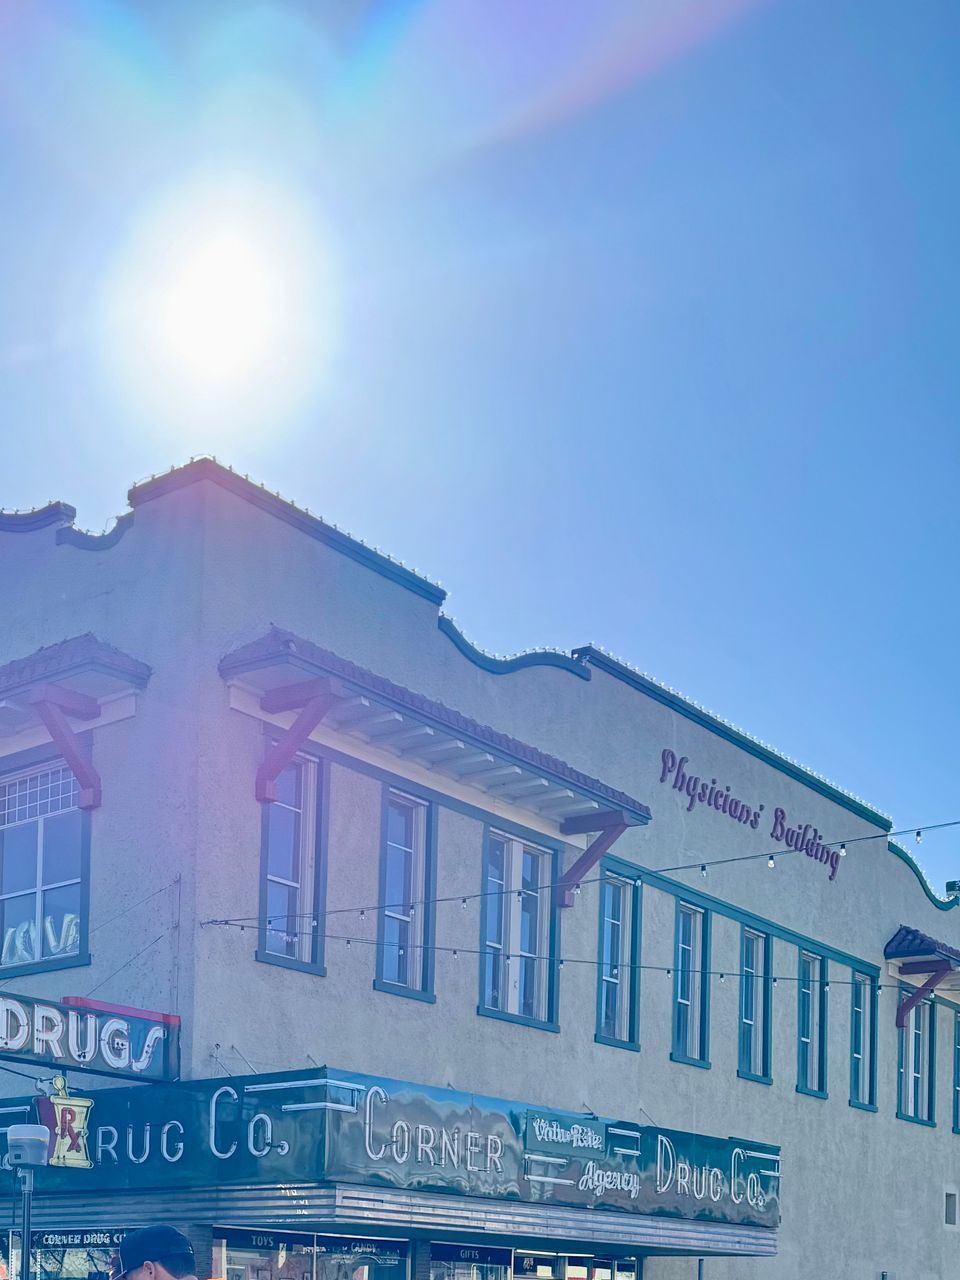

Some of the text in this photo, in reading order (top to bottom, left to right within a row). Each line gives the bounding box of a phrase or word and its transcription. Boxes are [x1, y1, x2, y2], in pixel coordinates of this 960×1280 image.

[770, 807, 840, 881] Building
[96, 1120, 185, 1166] RUG
[365, 1086, 505, 1174] CORNER
[578, 1160, 640, 1199] Agency
[656, 1134, 723, 1202] DRUG
[43, 1234, 81, 1245] CORNER
[83, 1233, 111, 1244] DRUG
[251, 1235, 274, 1247] TOYS
[460, 1249, 479, 1260] GIFTS
